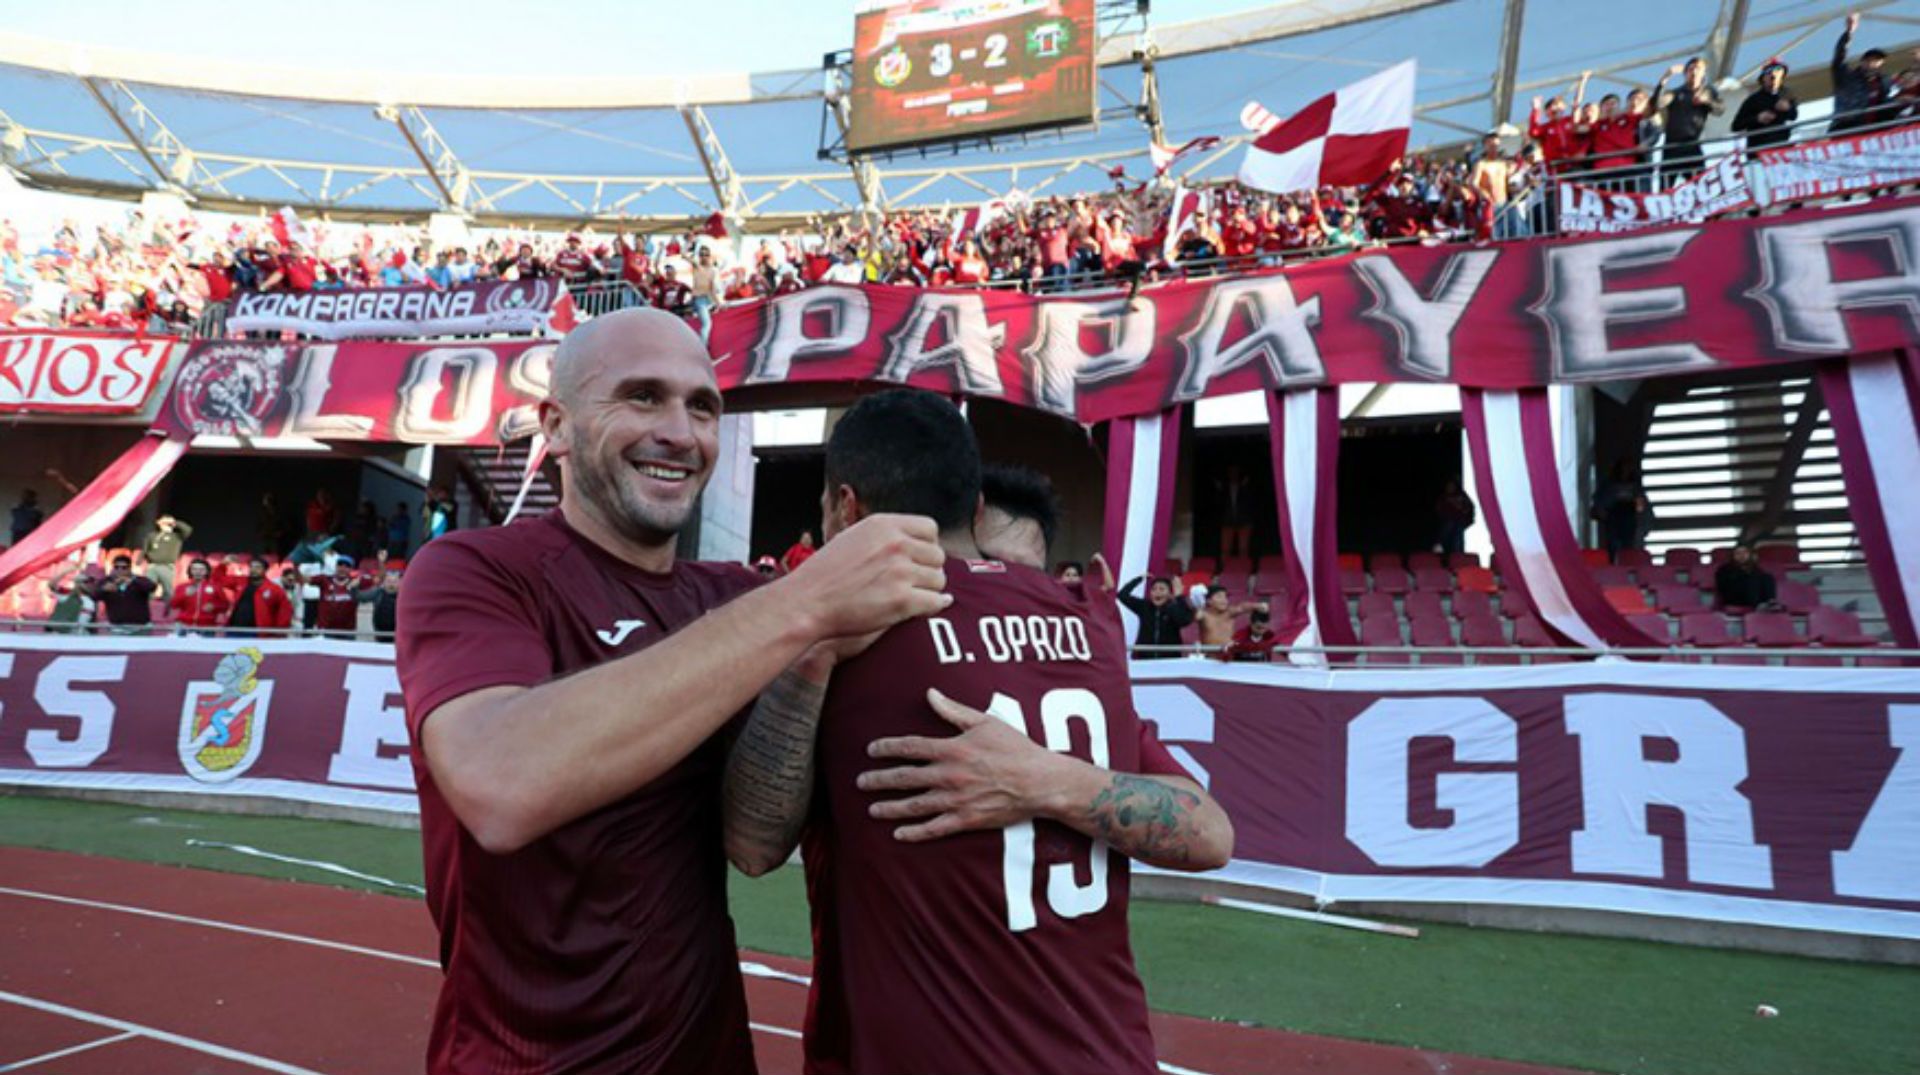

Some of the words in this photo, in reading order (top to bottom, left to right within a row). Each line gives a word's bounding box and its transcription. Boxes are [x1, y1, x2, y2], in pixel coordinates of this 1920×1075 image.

[930, 43, 952, 77] 3
[984, 33, 1008, 68] 2
[235, 290, 475, 321] KOMPAGRANA
[285, 344, 560, 442] LOS
[928, 617, 976, 664] D.
[978, 616, 1092, 663] OPAZO
[0, 653, 128, 768] S
